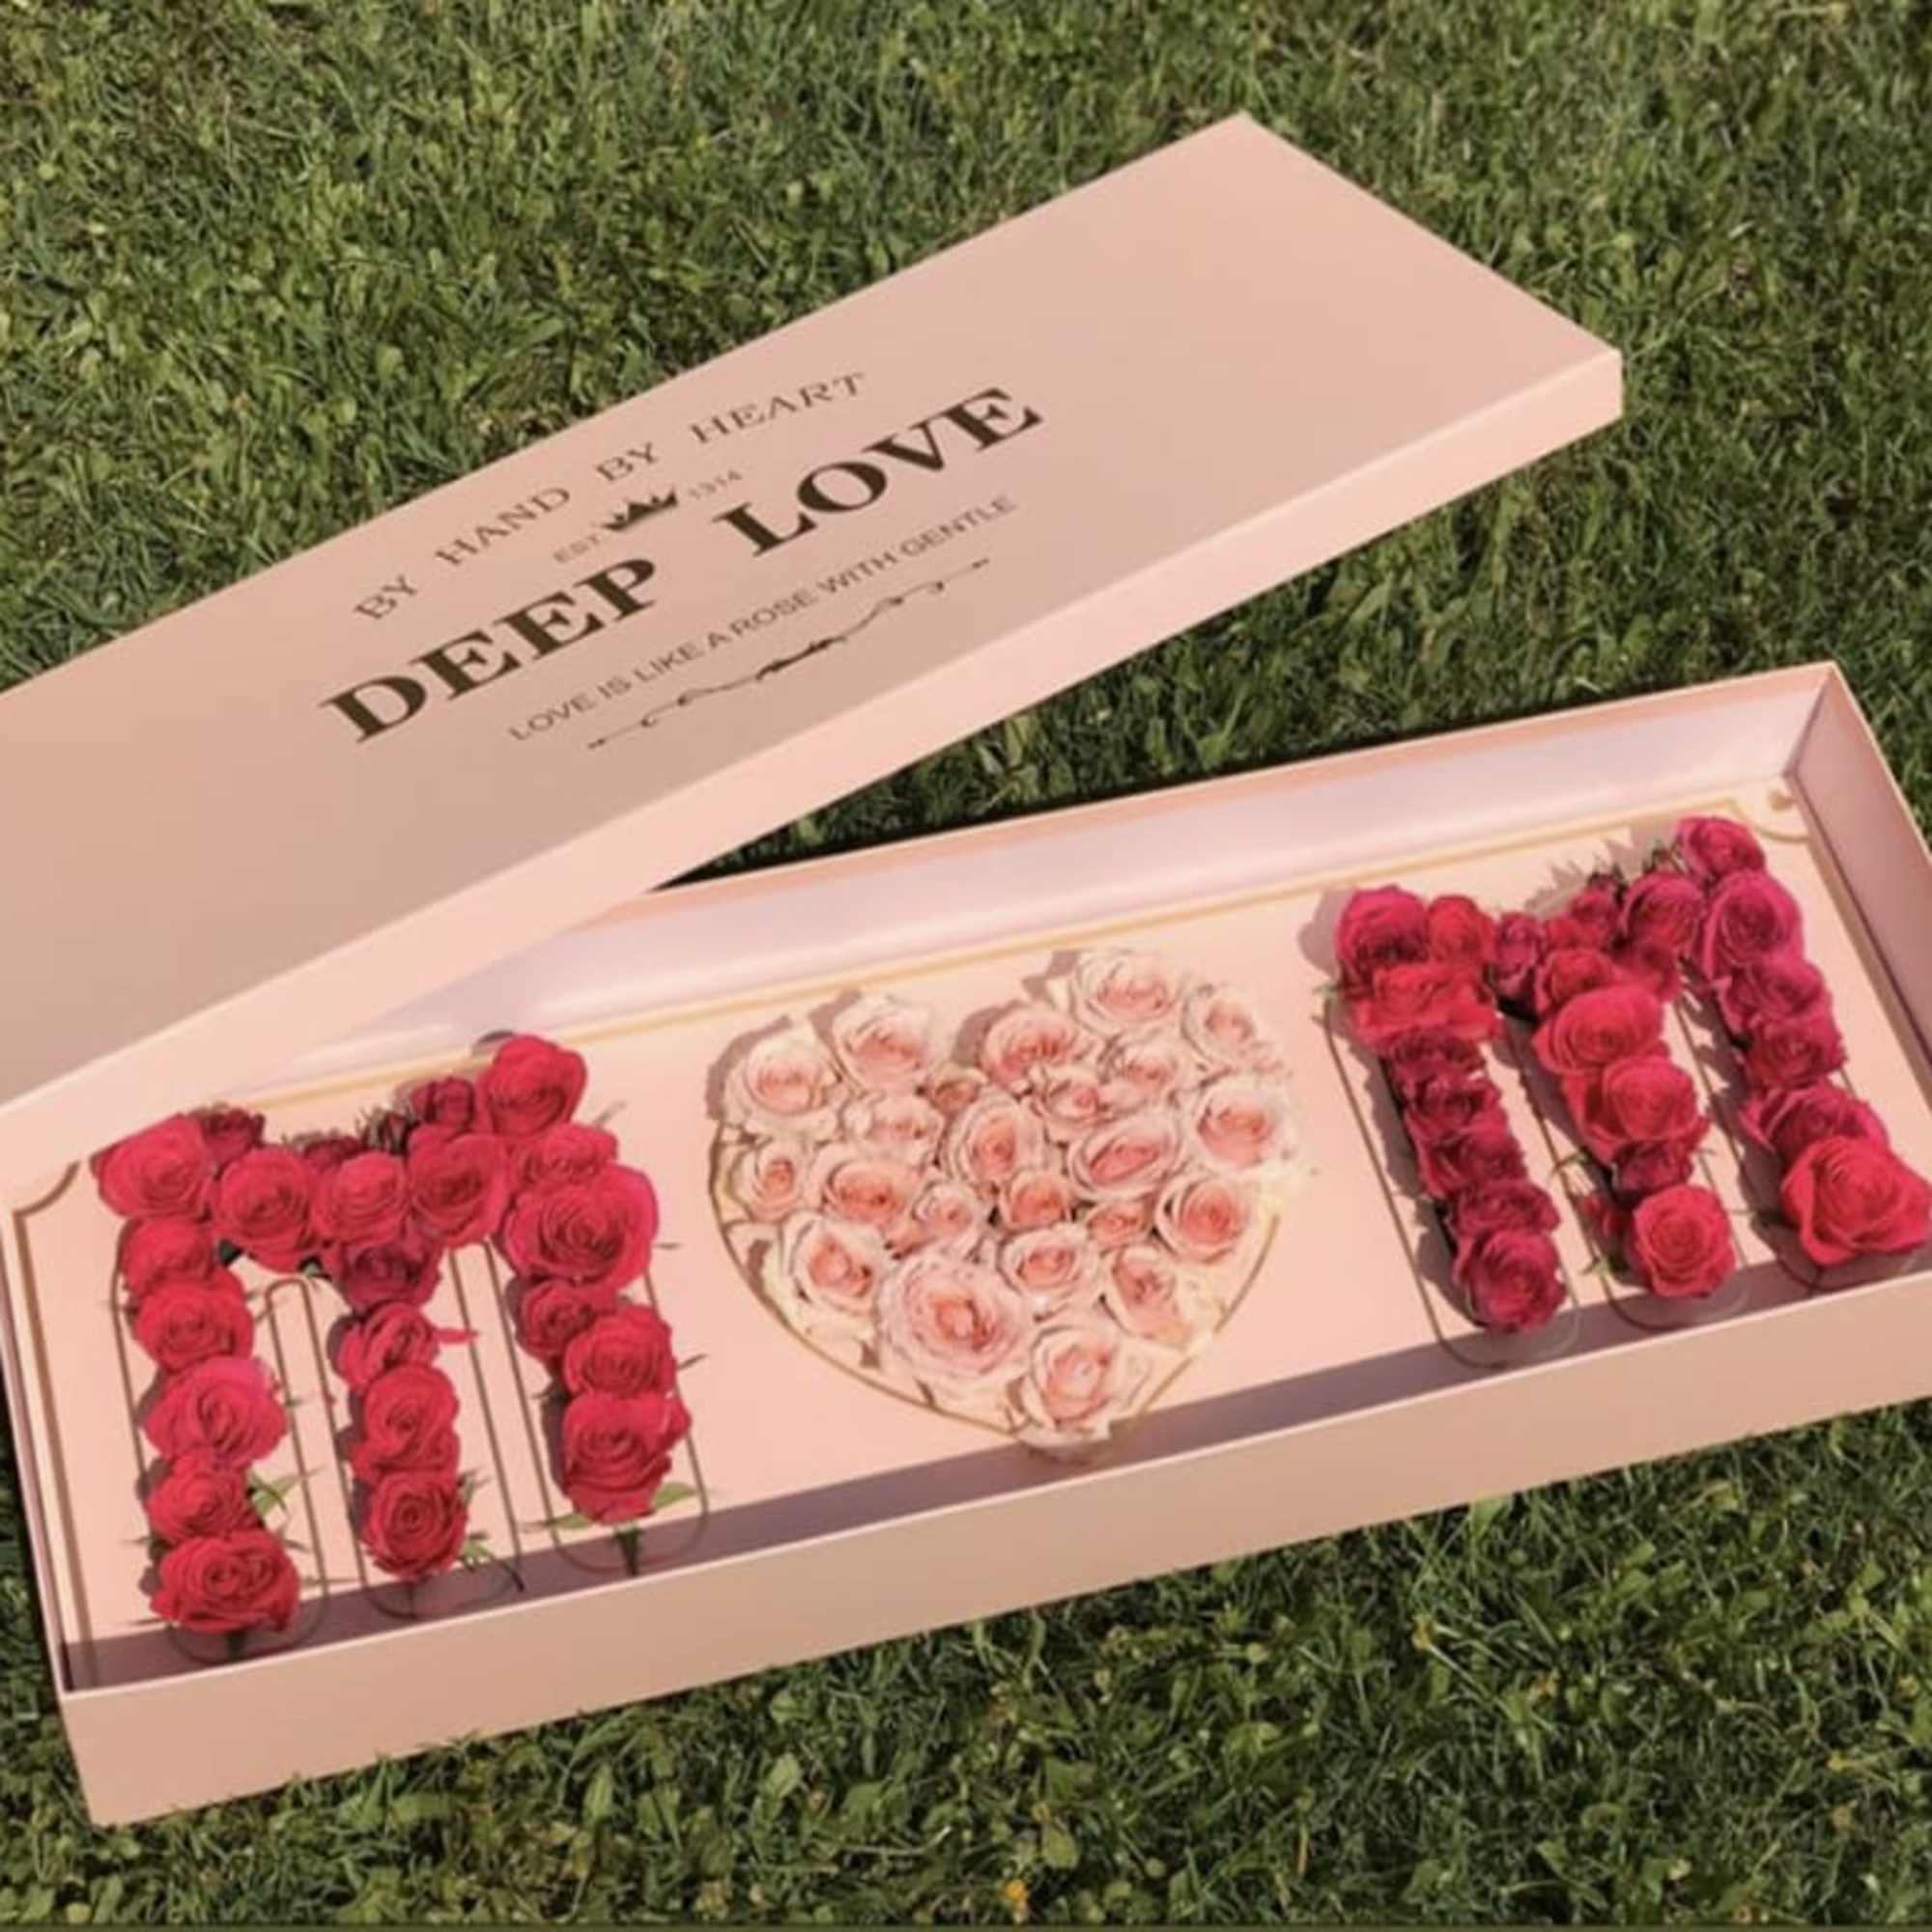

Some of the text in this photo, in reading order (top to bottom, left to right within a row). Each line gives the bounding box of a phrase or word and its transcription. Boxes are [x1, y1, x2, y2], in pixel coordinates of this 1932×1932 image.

[319, 387, 1045, 744] DEEP LOVE
[354, 371, 867, 619] BY HAND BY HEART
[508, 496, 1014, 741] LOVE IS LIKE A ROSE WITH GENTLE
